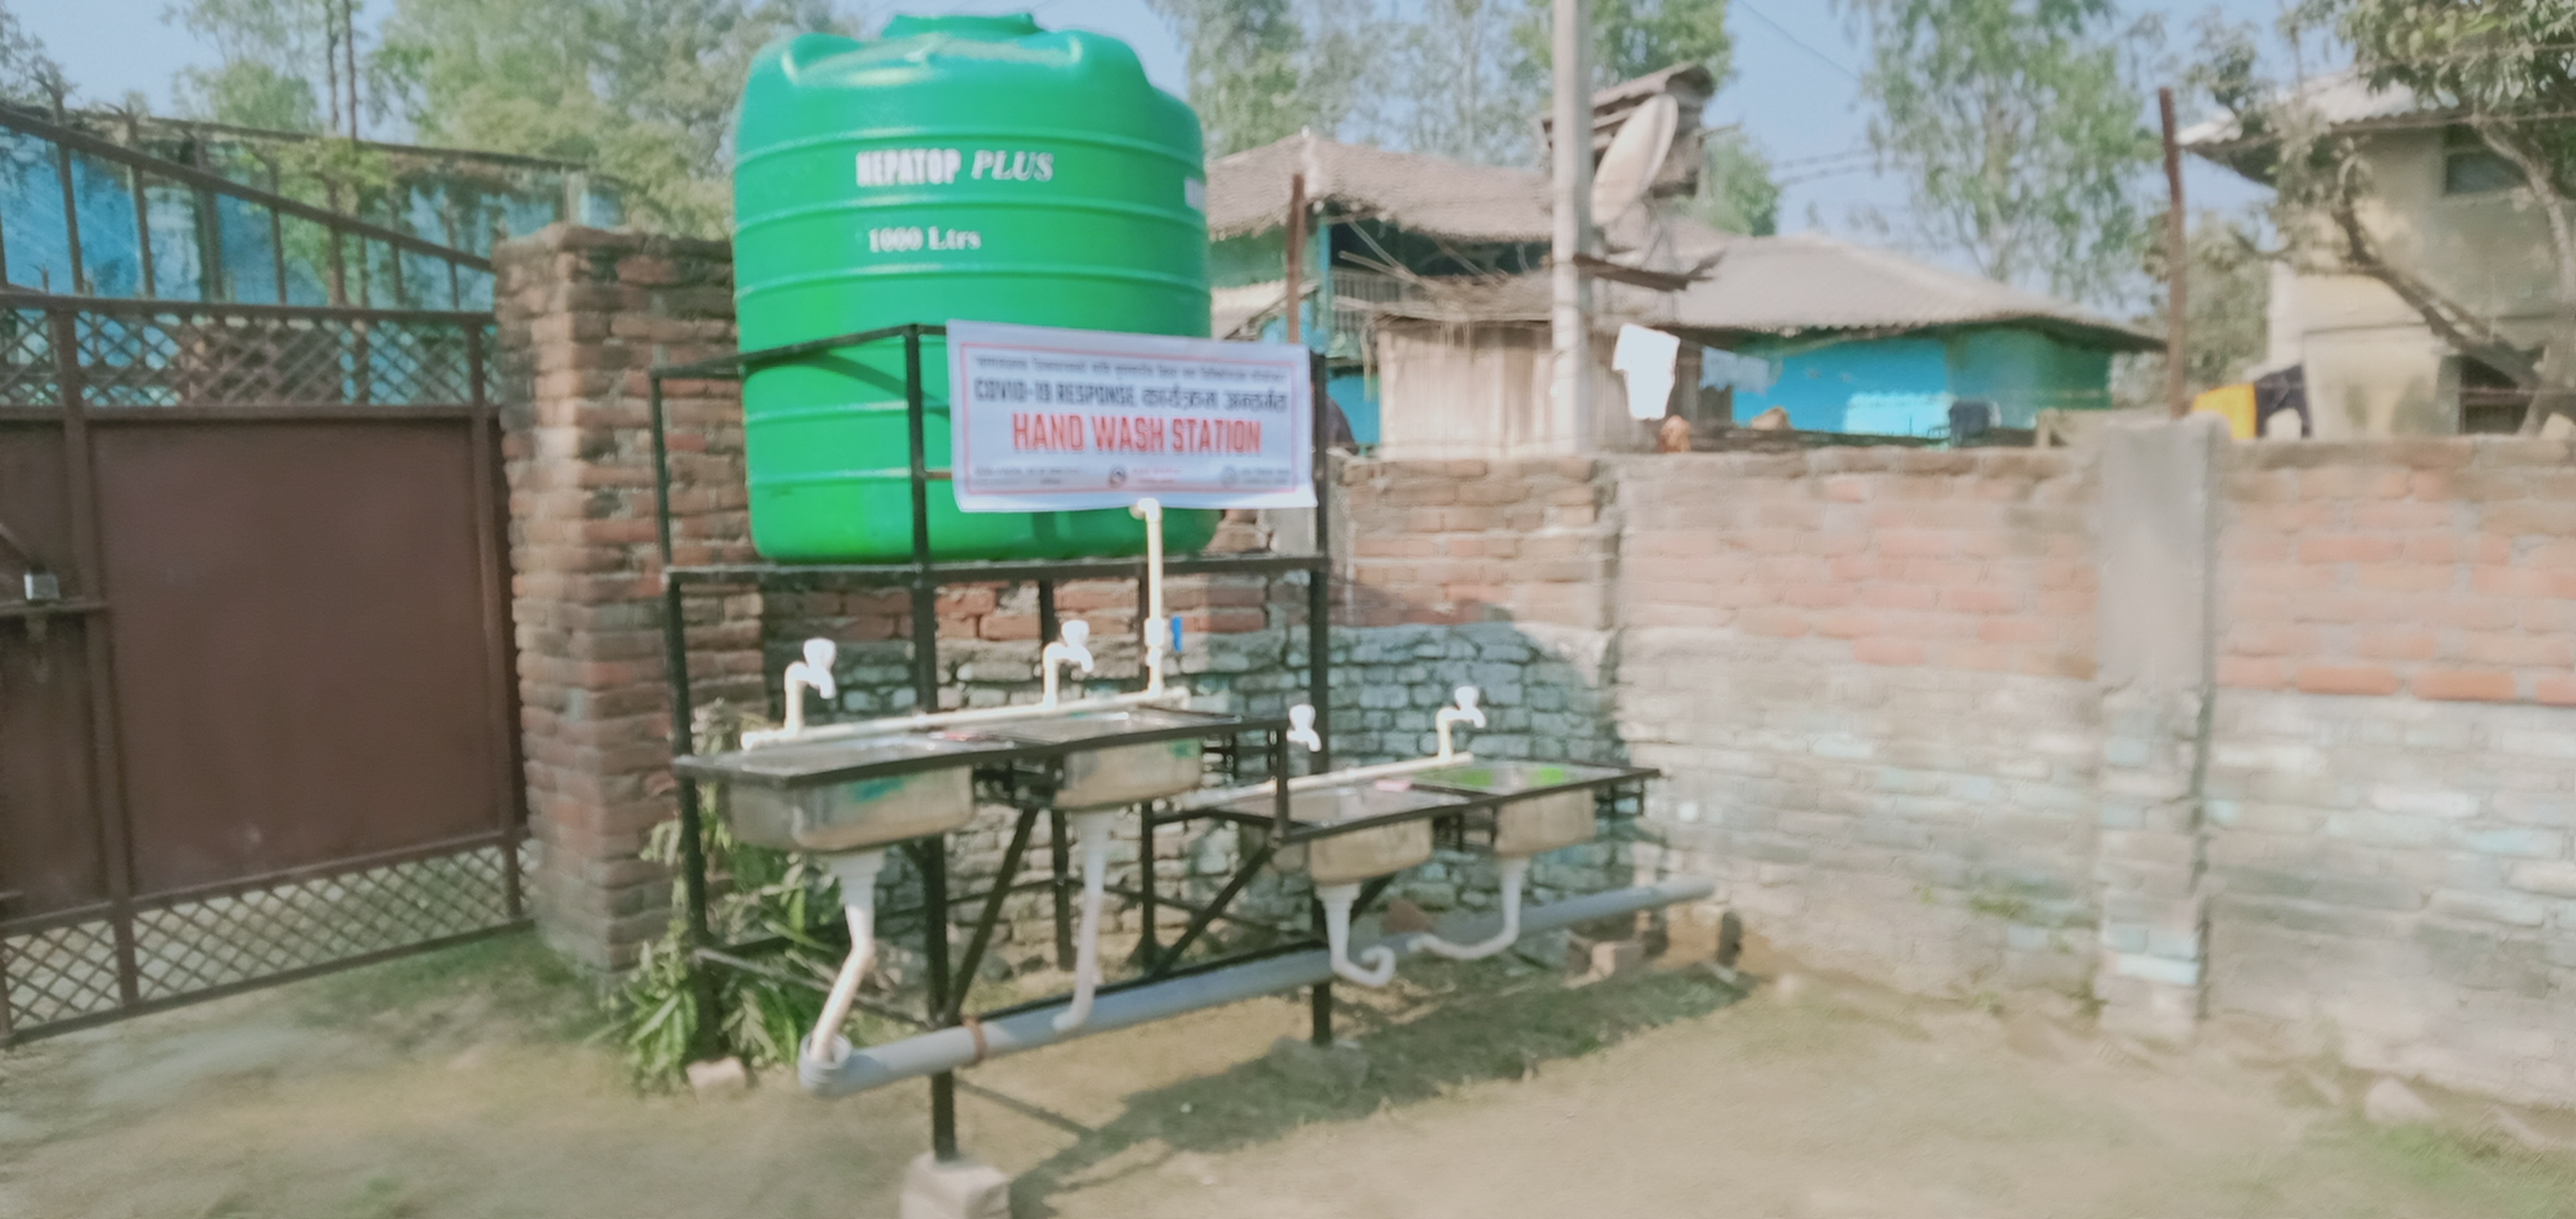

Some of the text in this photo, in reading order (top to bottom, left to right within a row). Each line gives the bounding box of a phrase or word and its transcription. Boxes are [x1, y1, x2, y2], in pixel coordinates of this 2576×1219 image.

[971, 150, 1054, 181] PLUS
[869, 226, 924, 252] 1000
[975, 379, 1052, 404] COVID-19
[1056, 382, 1137, 408] RESPONSE
[1012, 413, 1261, 455] HAND WASH STATION
